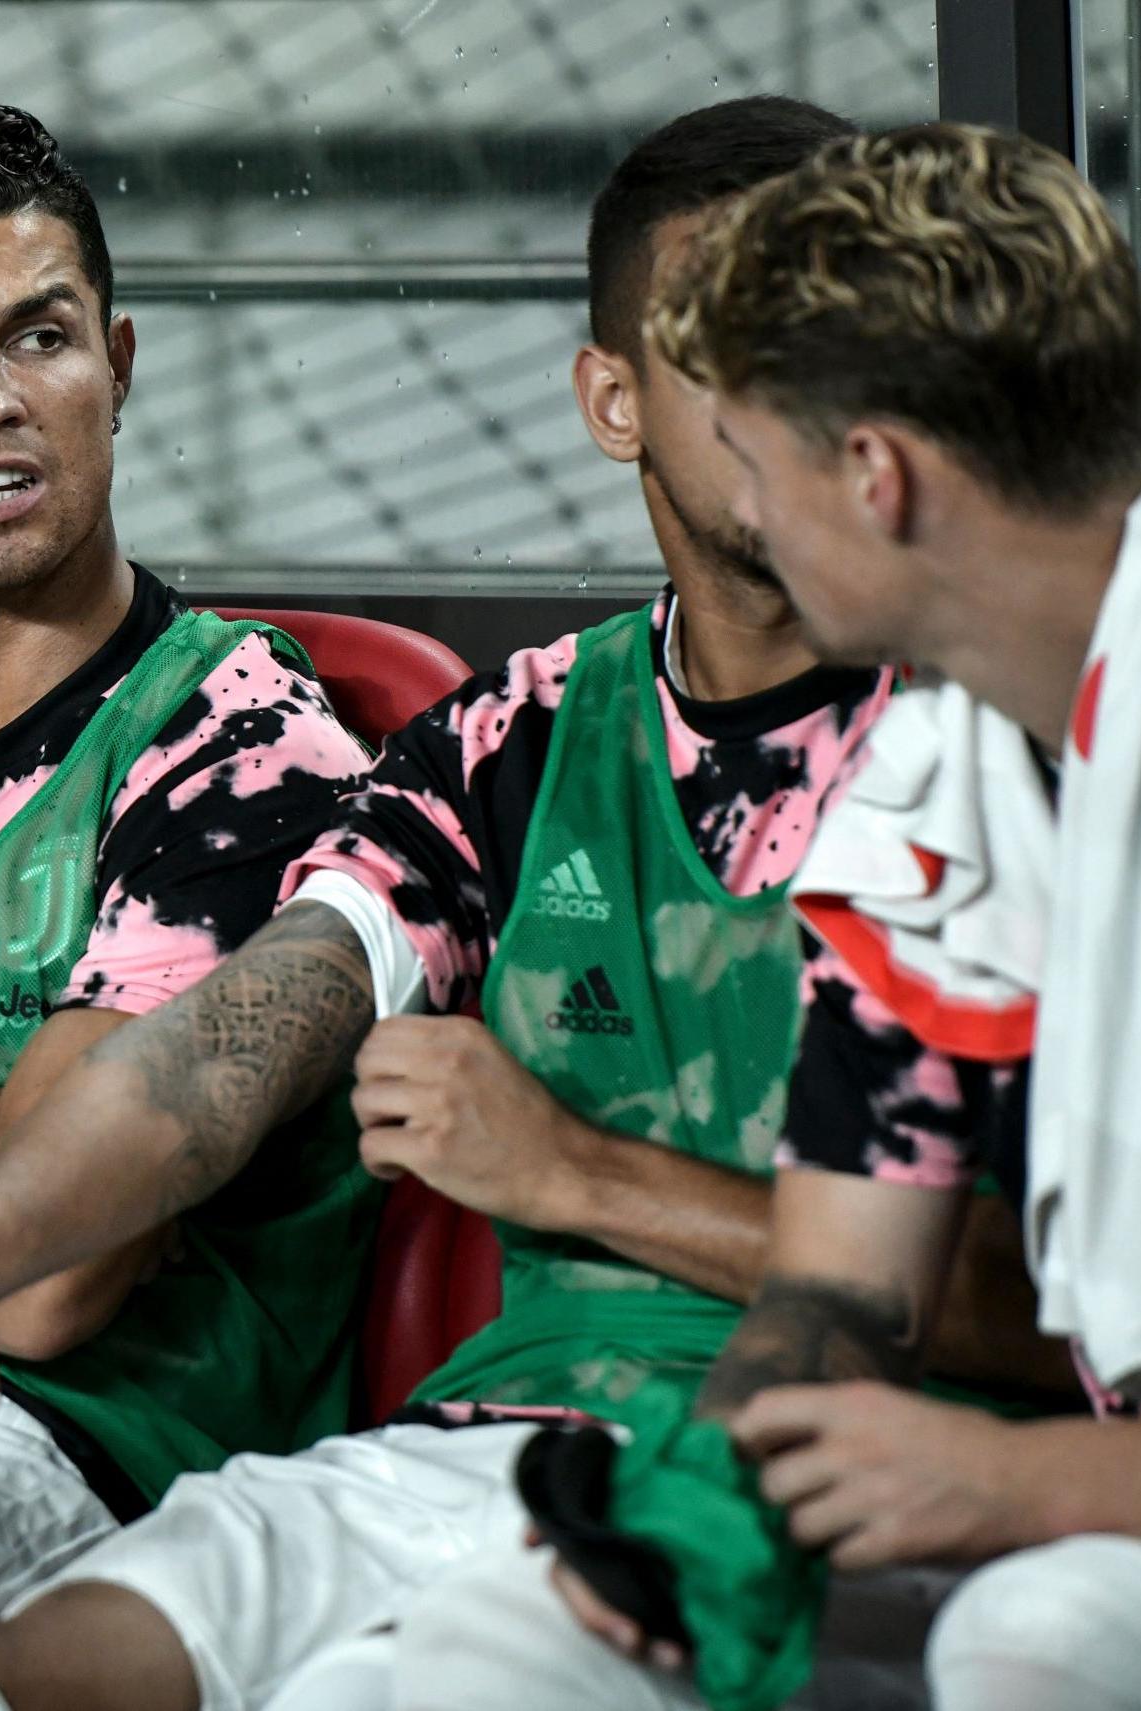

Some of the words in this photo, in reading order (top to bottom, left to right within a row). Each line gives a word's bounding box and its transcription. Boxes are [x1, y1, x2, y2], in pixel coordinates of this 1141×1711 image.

[531, 894, 612, 922] adidas
[0, 983, 52, 1021] Je
[545, 1008, 635, 1036] adidas
